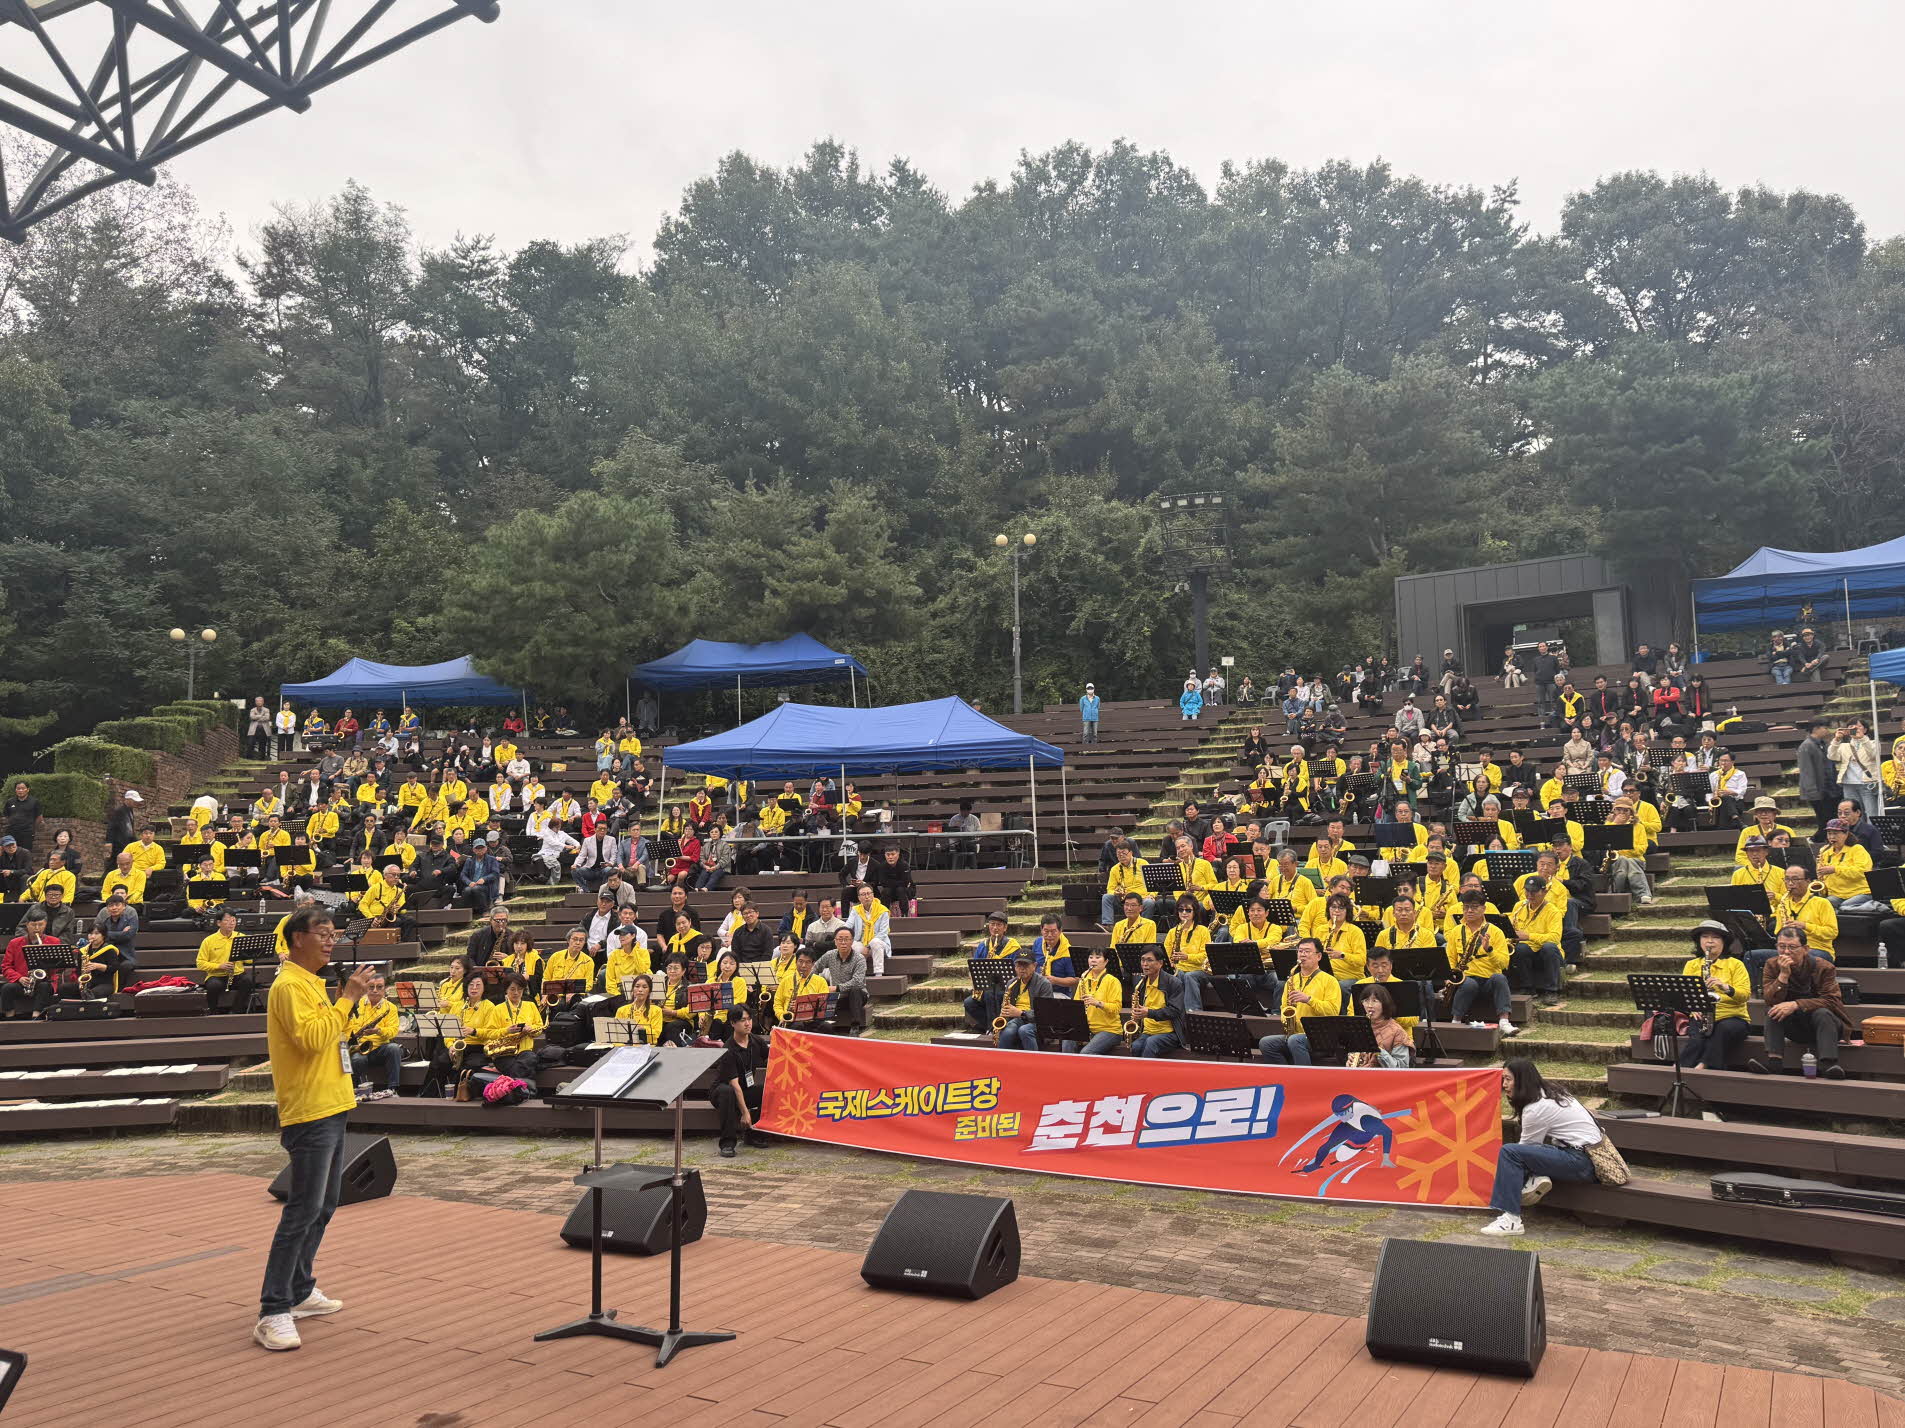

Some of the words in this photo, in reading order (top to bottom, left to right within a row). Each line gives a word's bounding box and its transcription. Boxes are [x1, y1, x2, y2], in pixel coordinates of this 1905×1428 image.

[818, 1077, 1001, 1120] 국제스케이트장
[1022, 1085, 1281, 1152] 춘천으로!
[954, 1111, 1021, 1140] 준비된
